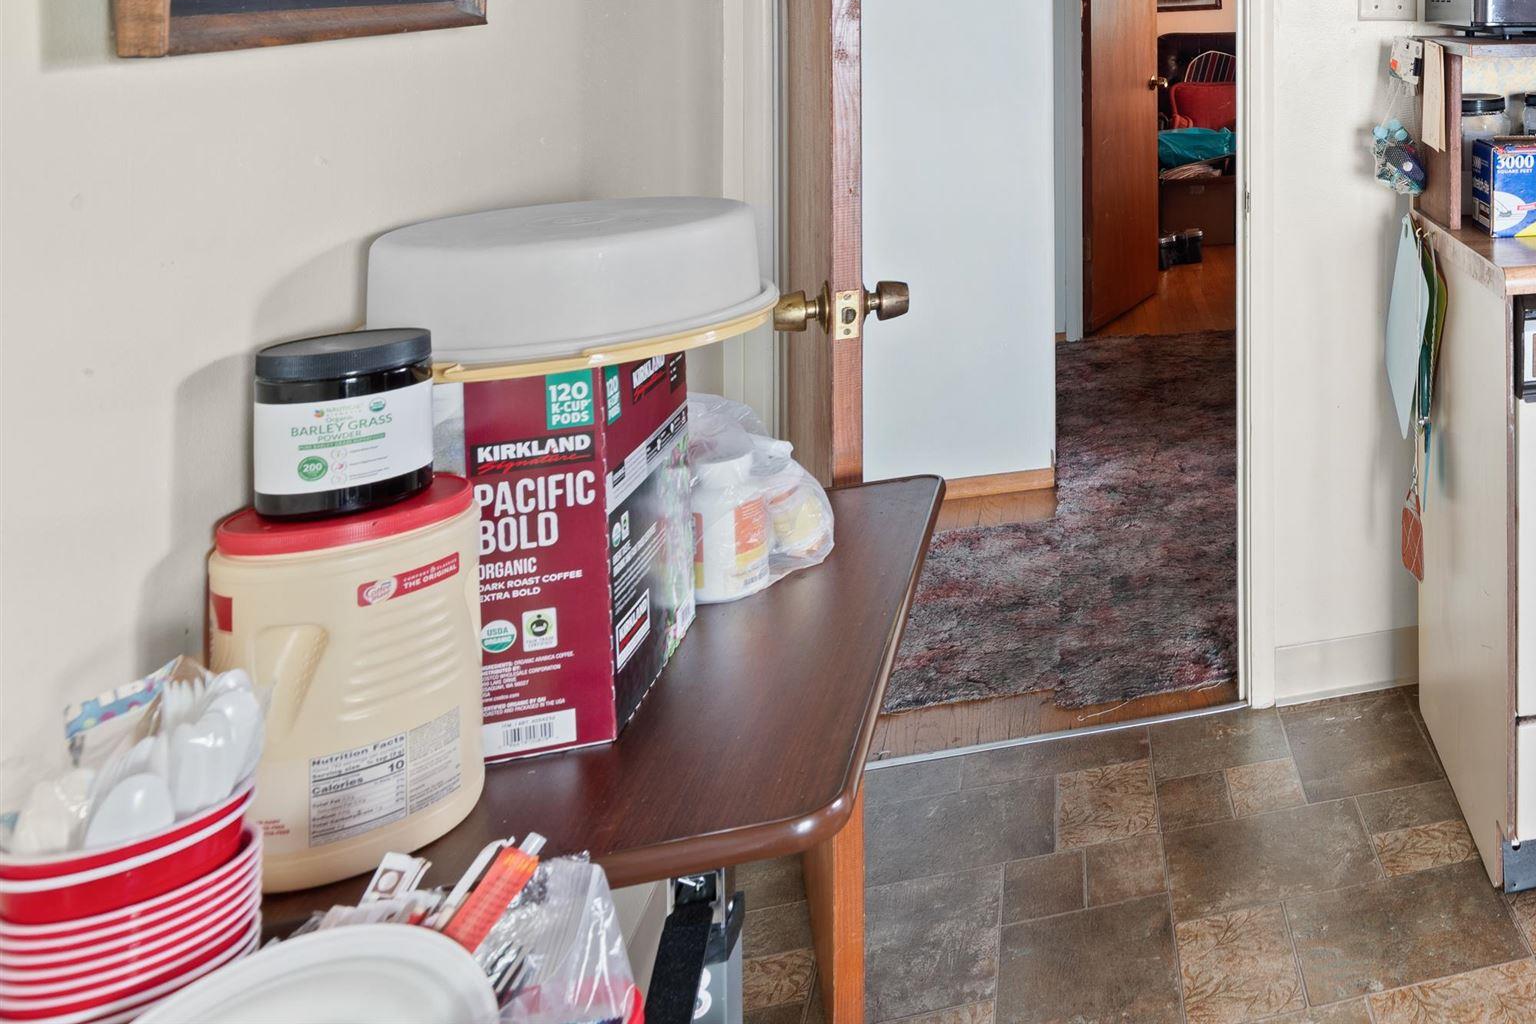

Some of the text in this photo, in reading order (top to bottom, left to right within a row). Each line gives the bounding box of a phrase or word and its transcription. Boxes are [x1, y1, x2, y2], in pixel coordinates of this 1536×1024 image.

[1496, 155, 1535, 169] 3000
[549, 382, 588, 402] 120
[552, 400, 589, 414] K-CUP
[291, 413, 393, 437] BARLEY GRASS
[552, 412, 590, 425] PODS
[318, 430, 361, 442] POWDER
[477, 434, 591, 463] KIRKLAND
[303, 463, 323, 472] 200
[476, 454, 591, 475] Signature
[474, 470, 596, 517] PACIFIC
[479, 511, 559, 556] BOLD
[403, 564, 457, 589] THE ORIGINAL
[479, 557, 537, 580] ORGANIC
[480, 570, 583, 592] DARK ROAST COFFEE
[480, 587, 541, 603] EXTRA BOLD
[487, 627, 509, 635] USDA
[312, 736, 405, 767] Nutrition Facts
[388, 760, 405, 773] 10
[312, 777, 364, 795] Calories
